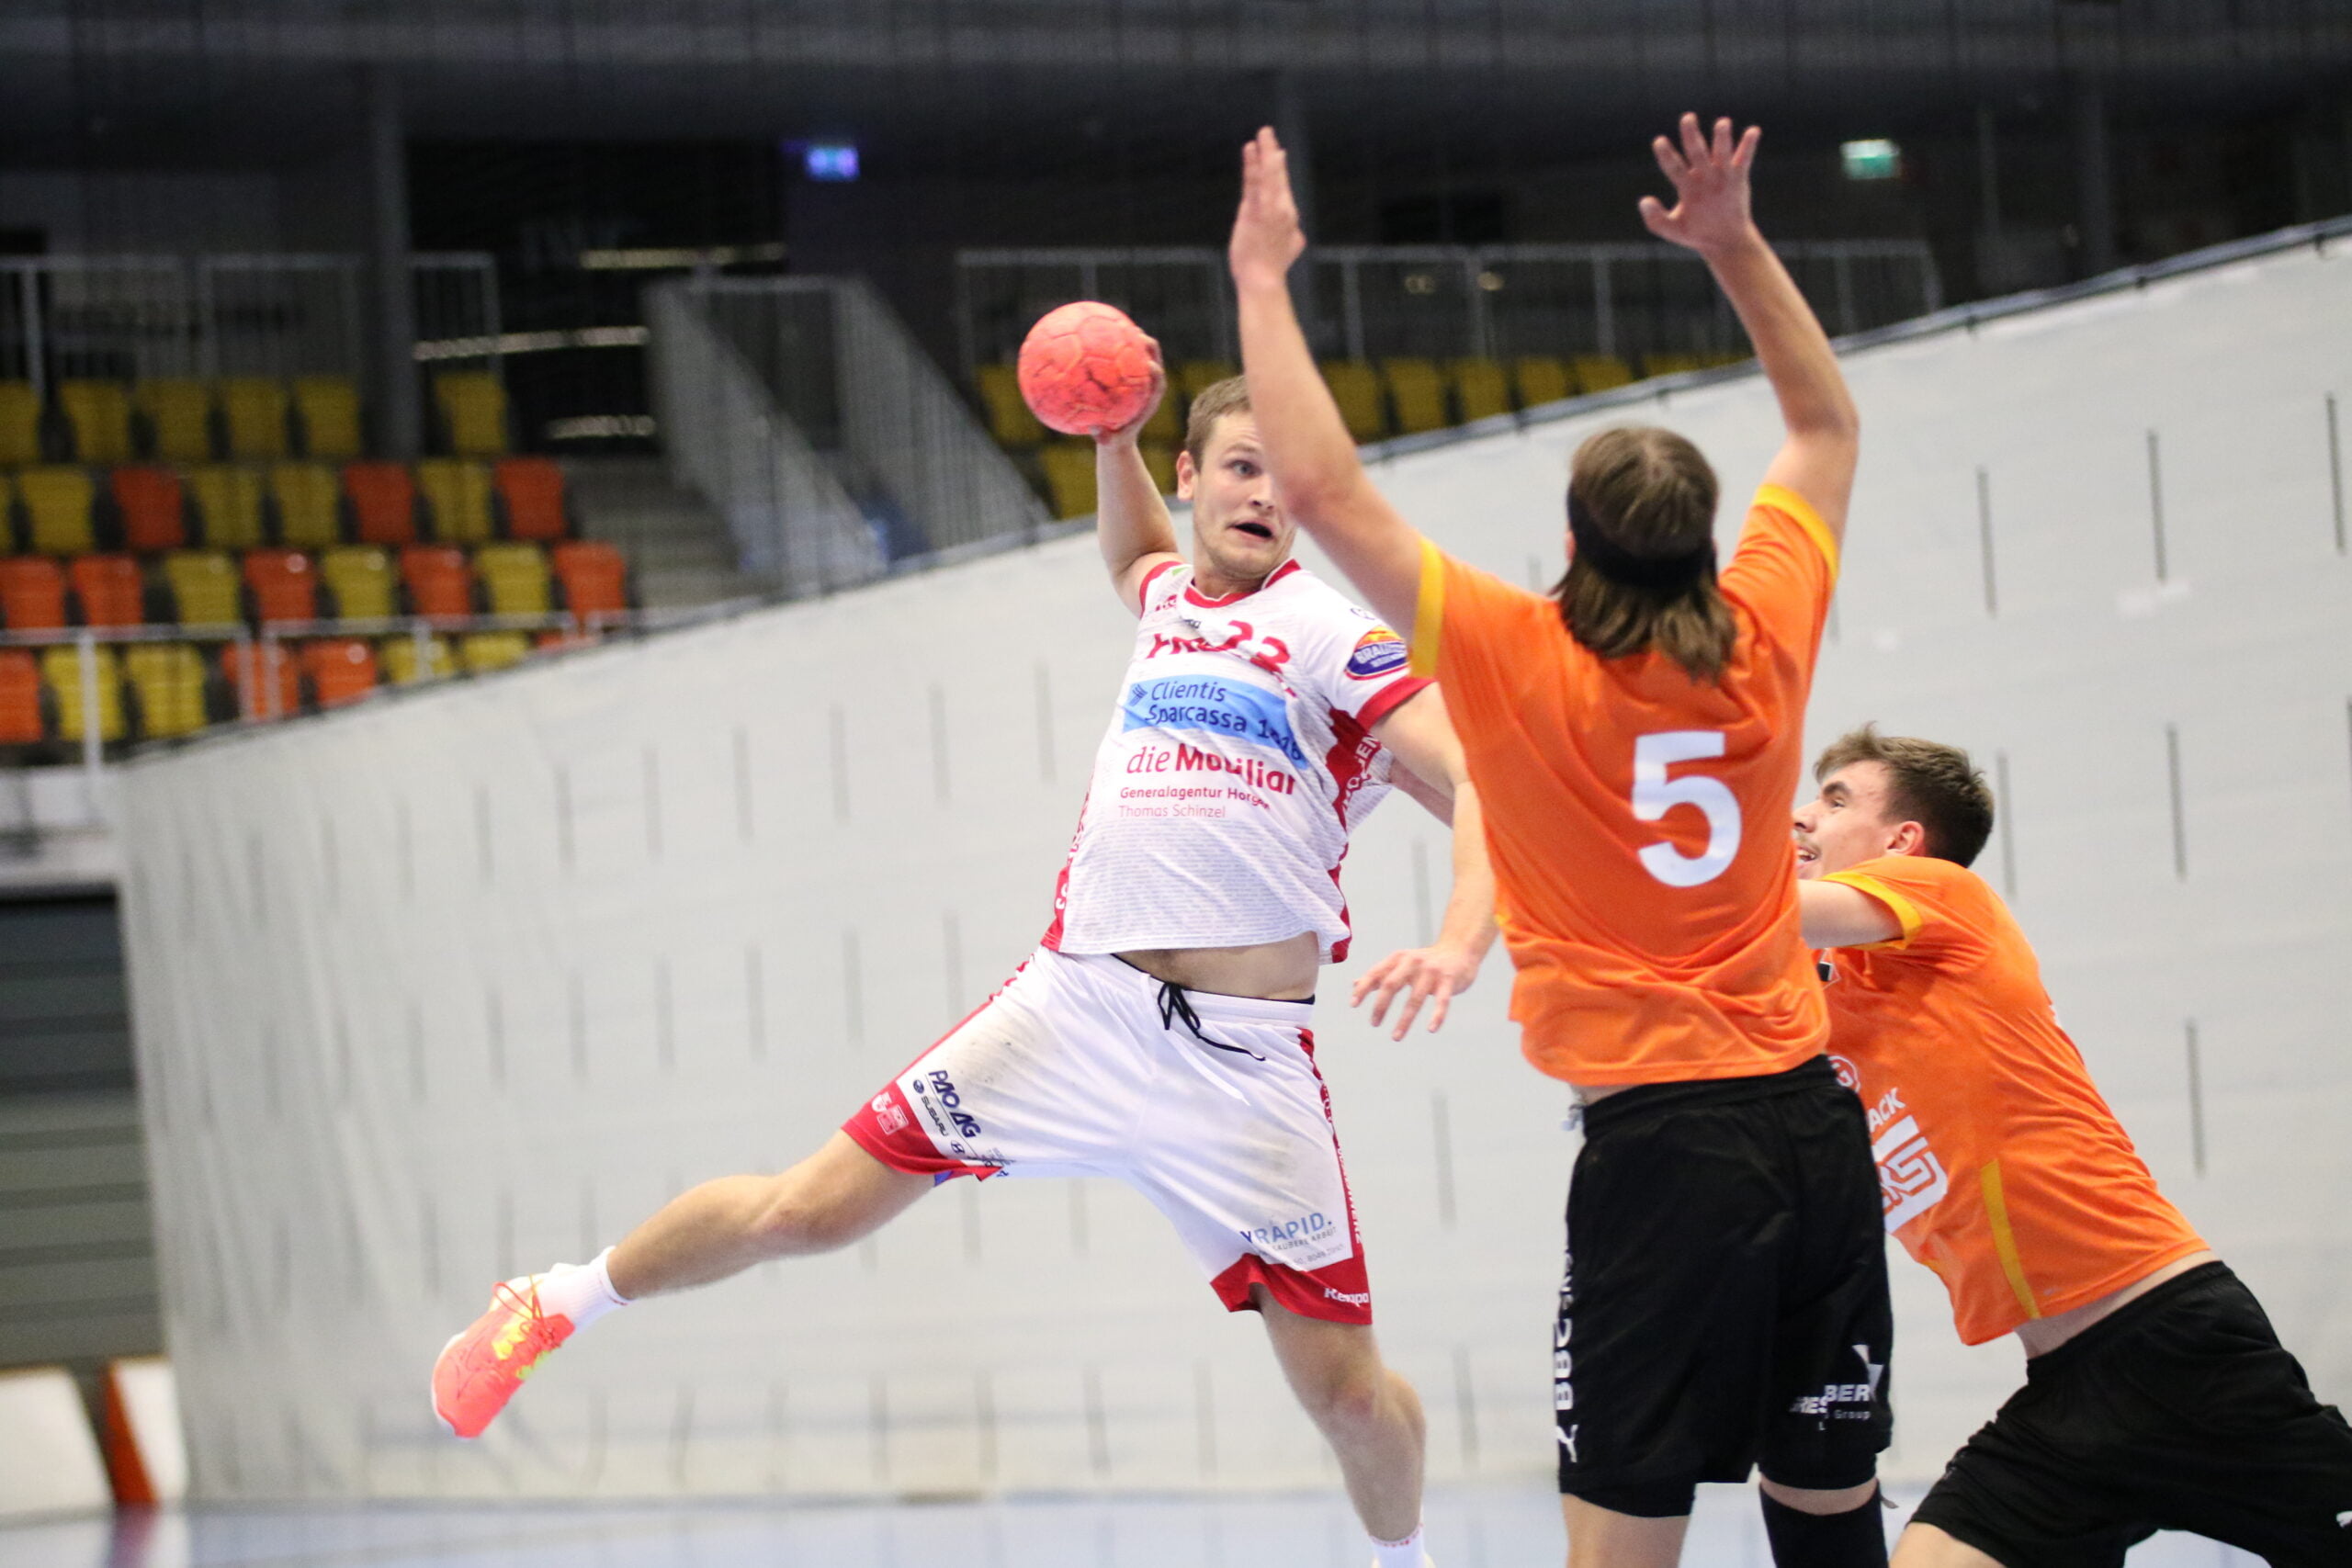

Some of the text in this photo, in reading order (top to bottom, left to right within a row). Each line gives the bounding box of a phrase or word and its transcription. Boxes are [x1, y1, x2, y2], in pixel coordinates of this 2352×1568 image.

[1151, 681, 1227, 702] Clientis
[1146, 704, 1248, 733] Sparcassa
[1126, 746, 1170, 773] die
[1120, 785, 1222, 800] Generalagentur
[1119, 803, 1227, 818] Thomas Schinzel
[1632, 730, 1742, 887] 5
[921, 1096, 949, 1137] SUBARU
[928, 1070, 981, 1138] PAO AG
[1866, 1087, 1906, 1134] ACK
